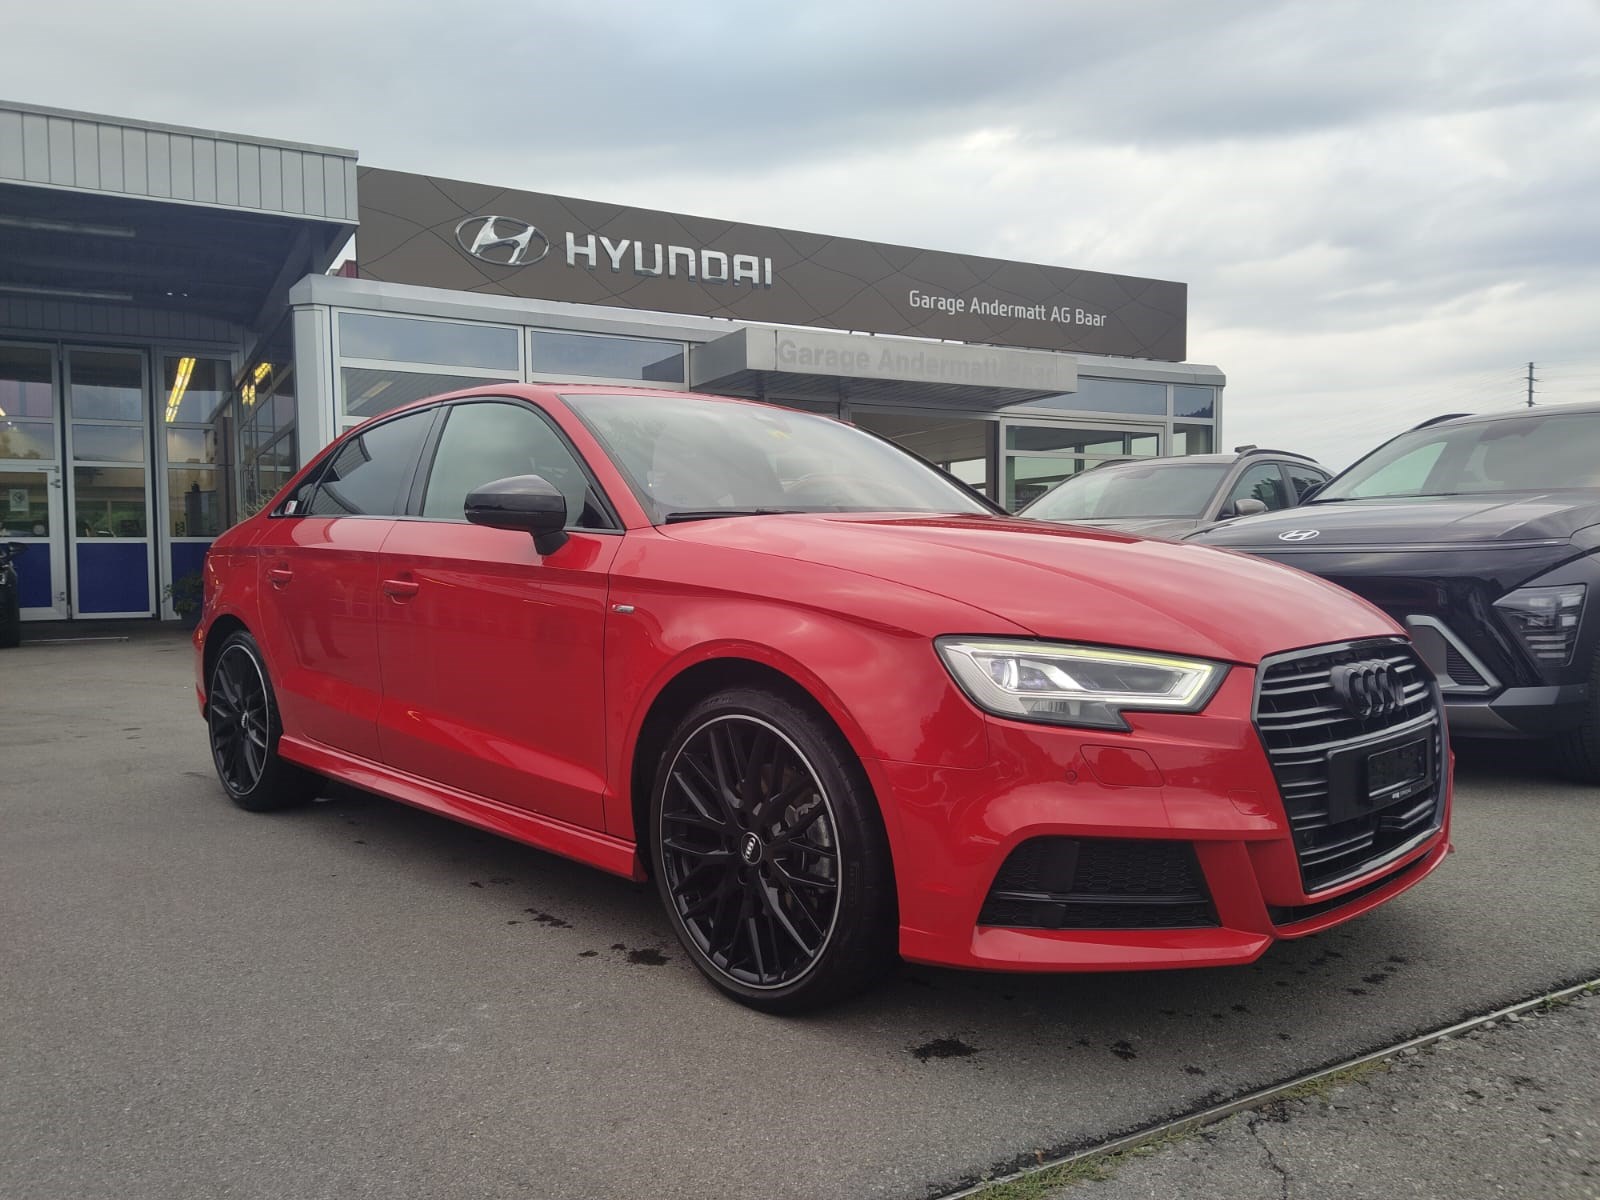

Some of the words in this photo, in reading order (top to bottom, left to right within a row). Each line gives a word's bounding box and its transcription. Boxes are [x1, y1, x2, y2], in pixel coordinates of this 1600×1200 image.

[565, 231, 772, 287] HYUNDAI
[909, 290, 965, 315] Garage
[970, 297, 1047, 320] Andermatt
[1050, 306, 1071, 323] AG
[1075, 309, 1107, 327] Baar
[779, 339, 871, 374] Garage
